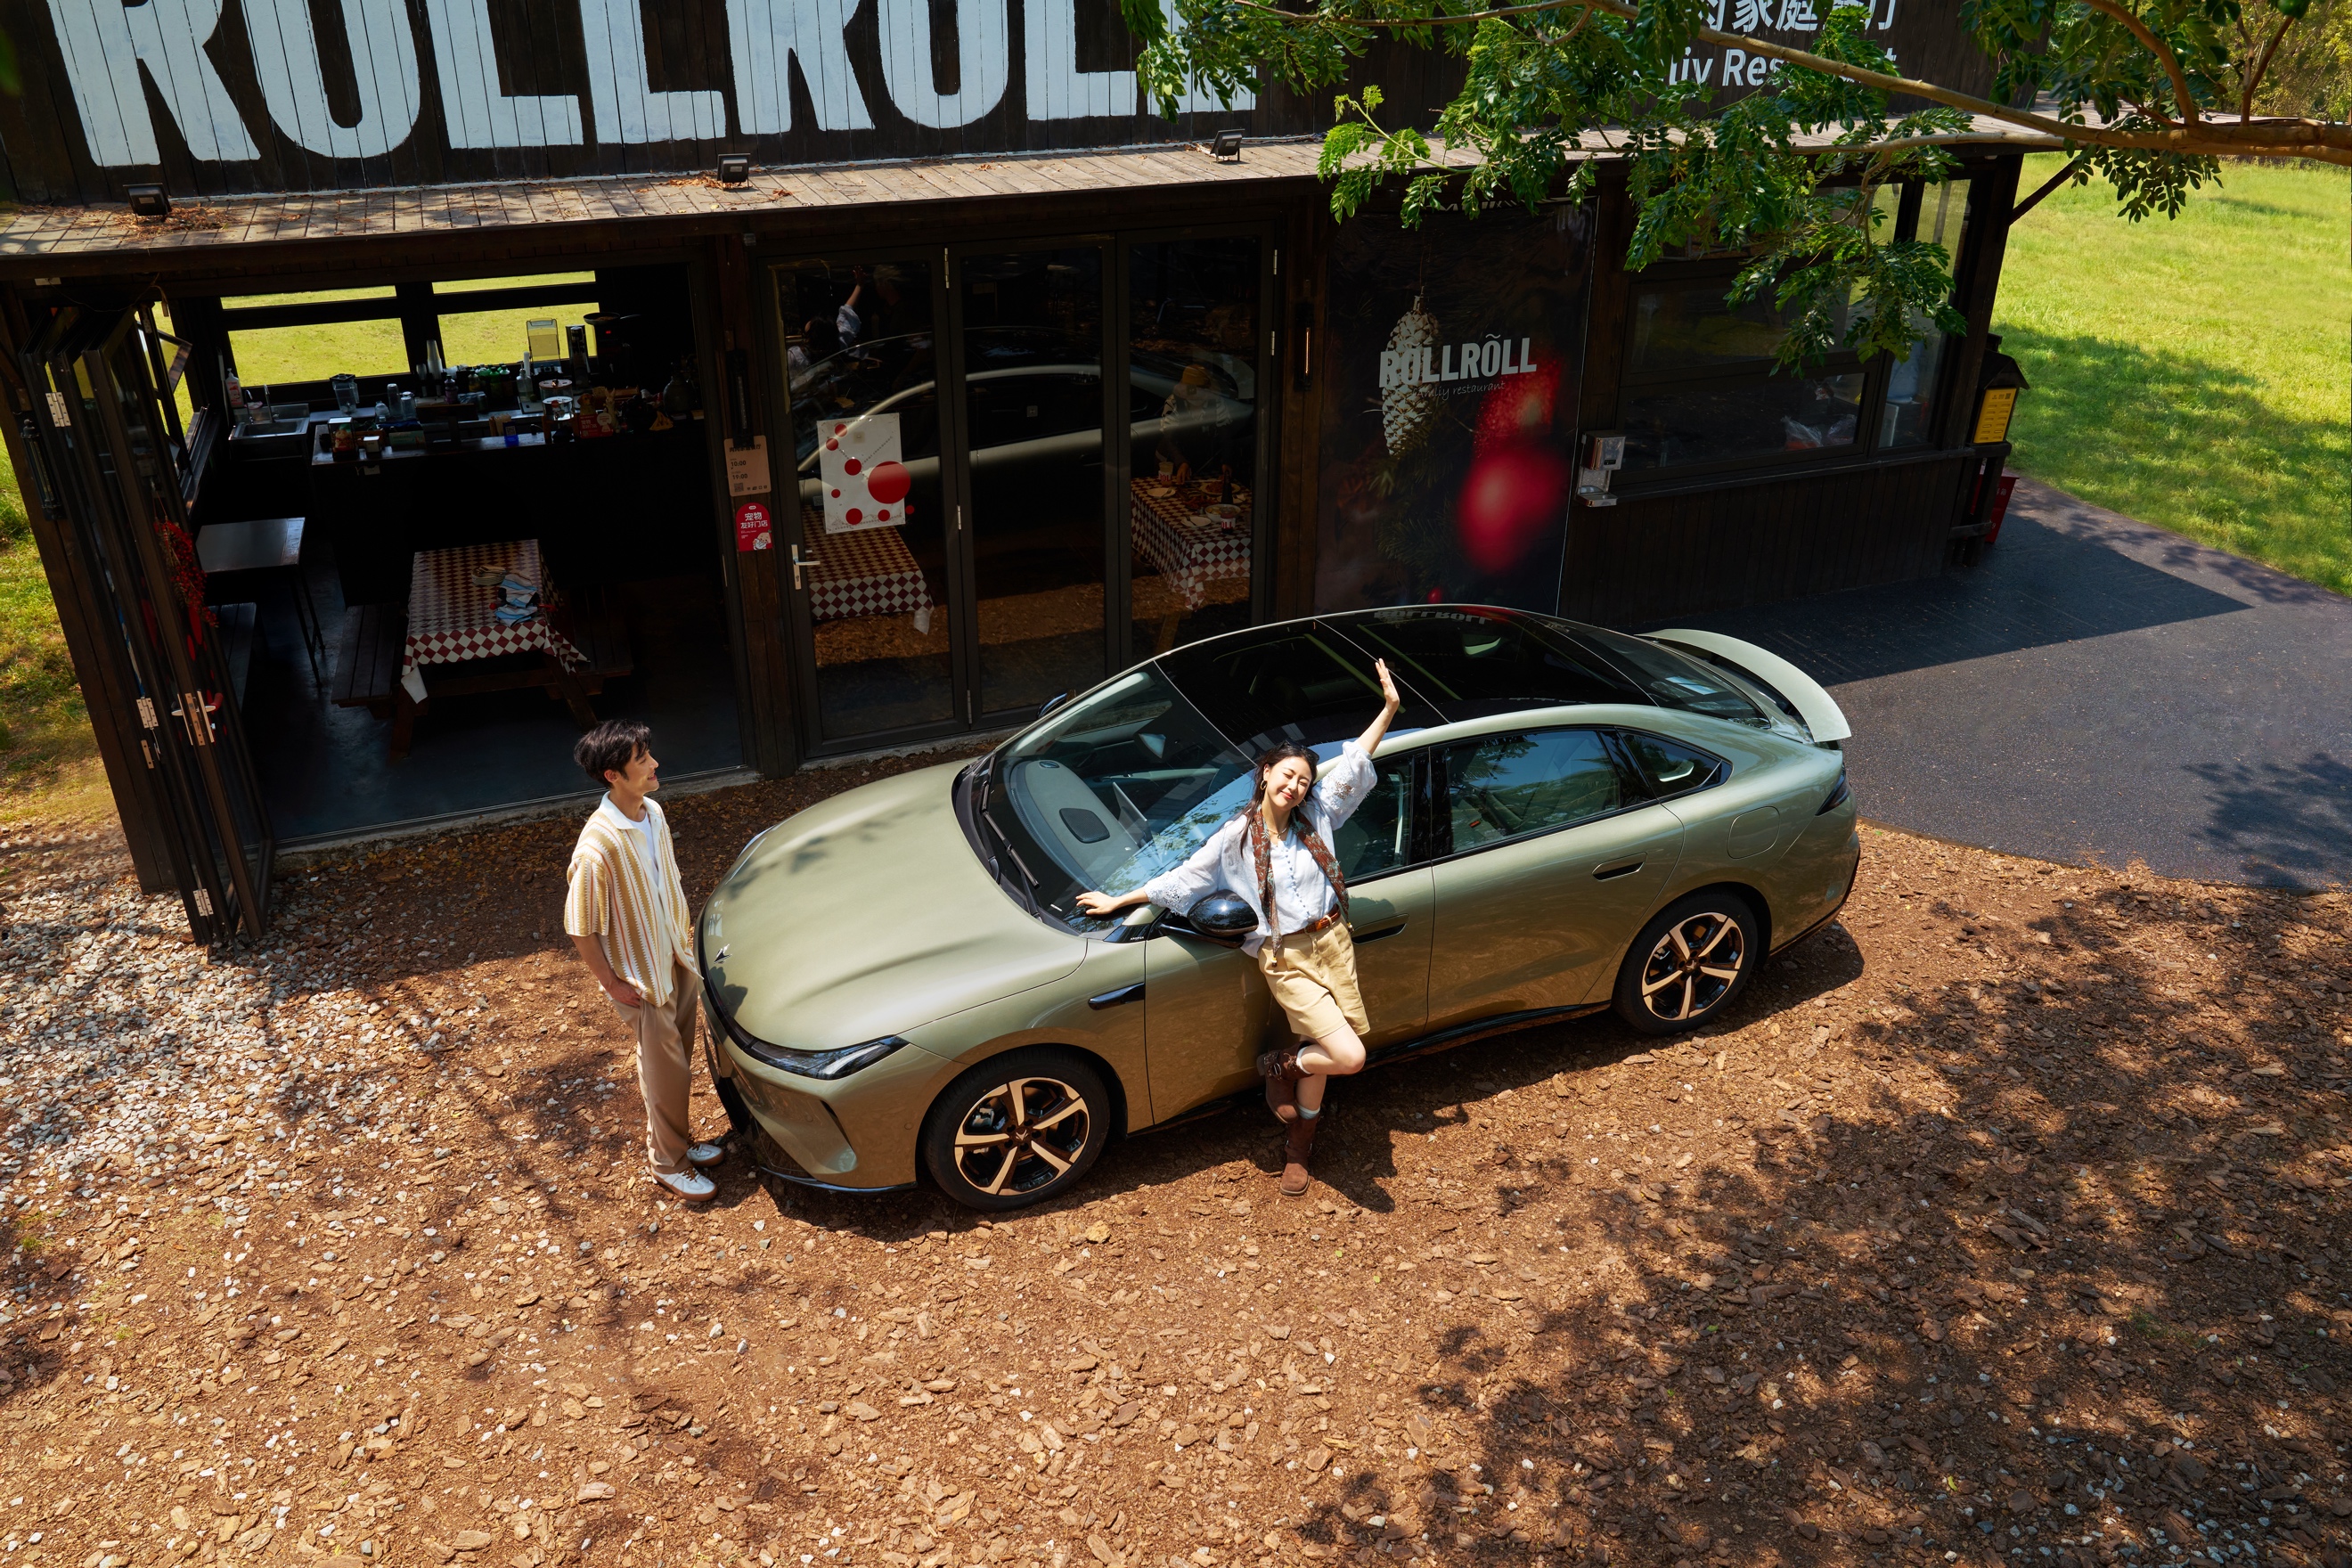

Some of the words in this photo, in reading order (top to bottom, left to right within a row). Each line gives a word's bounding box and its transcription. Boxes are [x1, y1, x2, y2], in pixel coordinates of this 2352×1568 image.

[1453, 380, 1507, 395] restaurant
[745, 512, 762, 521] 宠物
[740, 520, 768, 528] 友好门店
